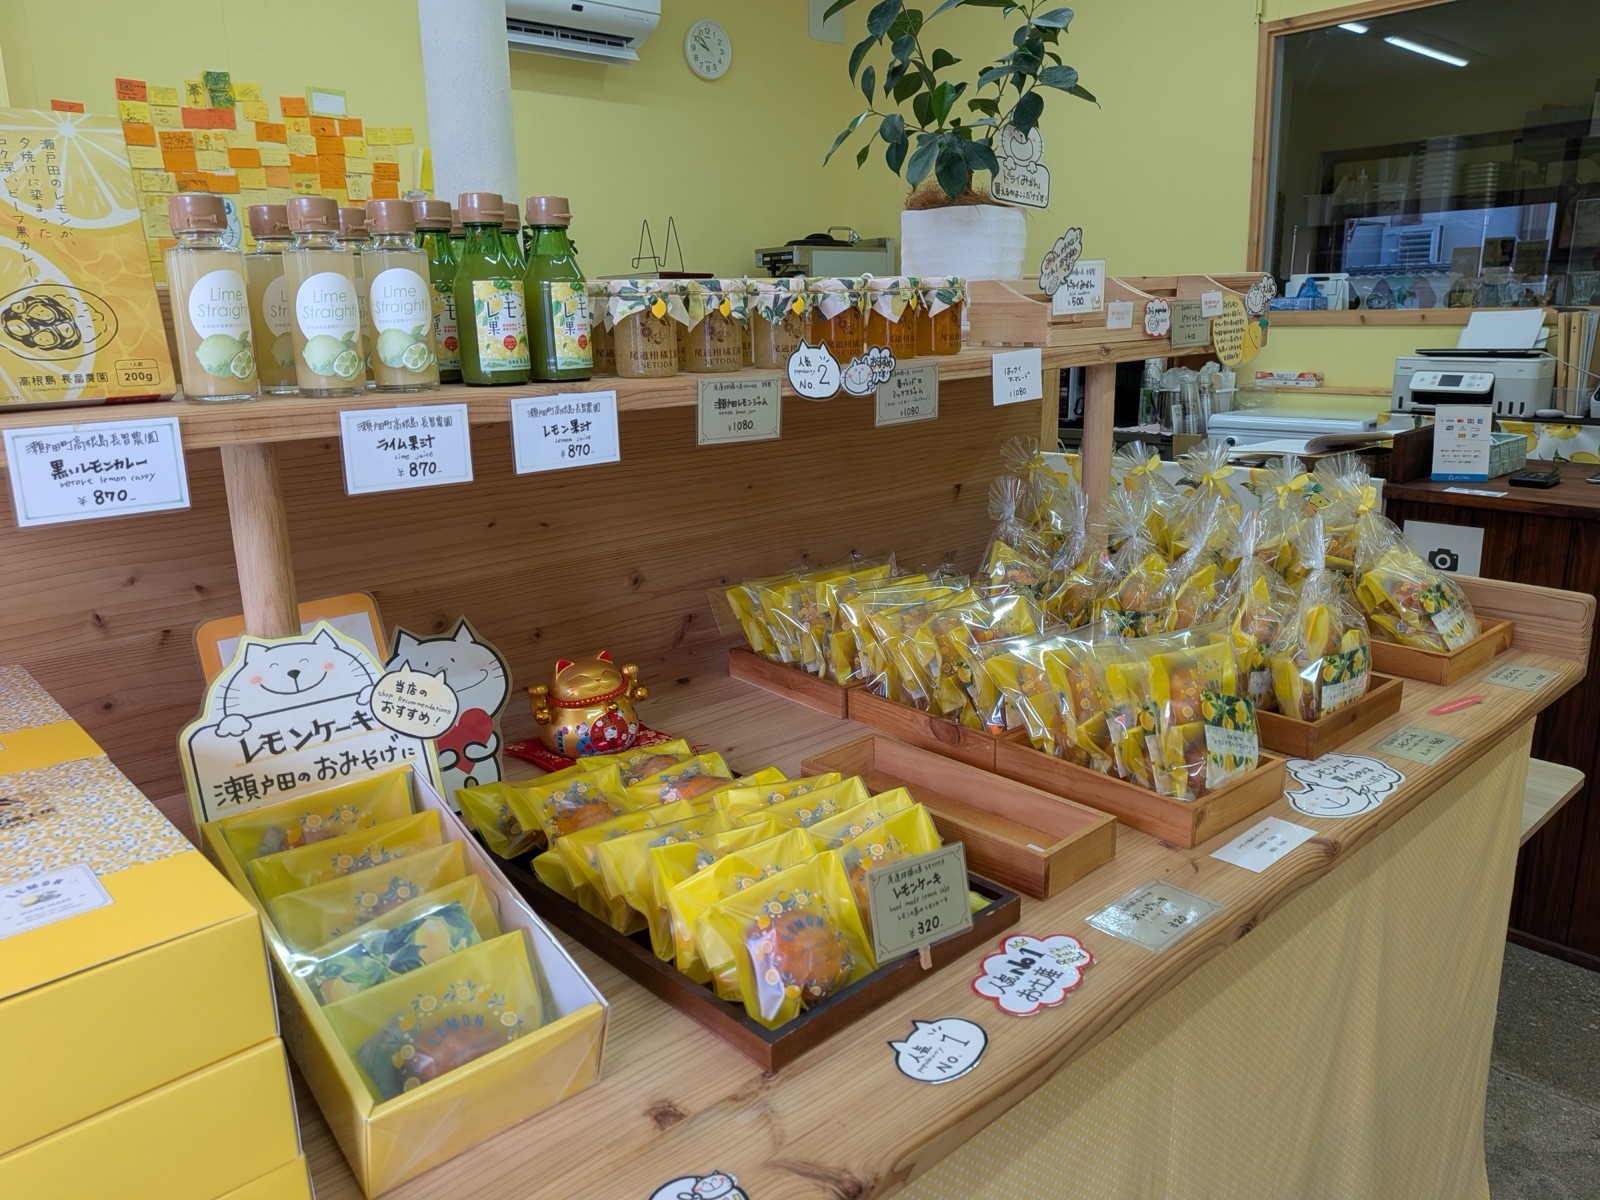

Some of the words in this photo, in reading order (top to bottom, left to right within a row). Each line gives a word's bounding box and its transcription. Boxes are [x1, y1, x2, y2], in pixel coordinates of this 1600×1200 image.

[210, 287, 243, 302] Lime
[312, 289, 347, 304] Lime
[383, 285, 417, 299] Lime
[303, 305, 358, 321] Straight!
[375, 299, 428, 315] Straight!
[640, 361, 674, 369] SETODA
[798, 356, 812, 367] 人気
[124, 372, 153, 382] 200g
[542, 418, 592, 438] レモン果汁
[376, 434, 436, 451] ライム果汁
[50, 457, 149, 481] 黒いレモンカレー
[100, 474, 127, 484] lemon
[130, 472, 156, 483] curry
[396, 680, 428, 698] 当店の
[381, 700, 441, 726] おすすめ!
[398, 696, 452, 714] Recommendations
[213, 734, 416, 807] 瀬戸田のおみやげに
[892, 871, 942, 900] レモンケーキ
[889, 902, 902, 913] hand
[781, 914, 824, 942] LEMON
[1168, 914, 1188, 929] 320
[426, 1012, 485, 1047] LEMON
[908, 1044, 933, 1065] 人気
